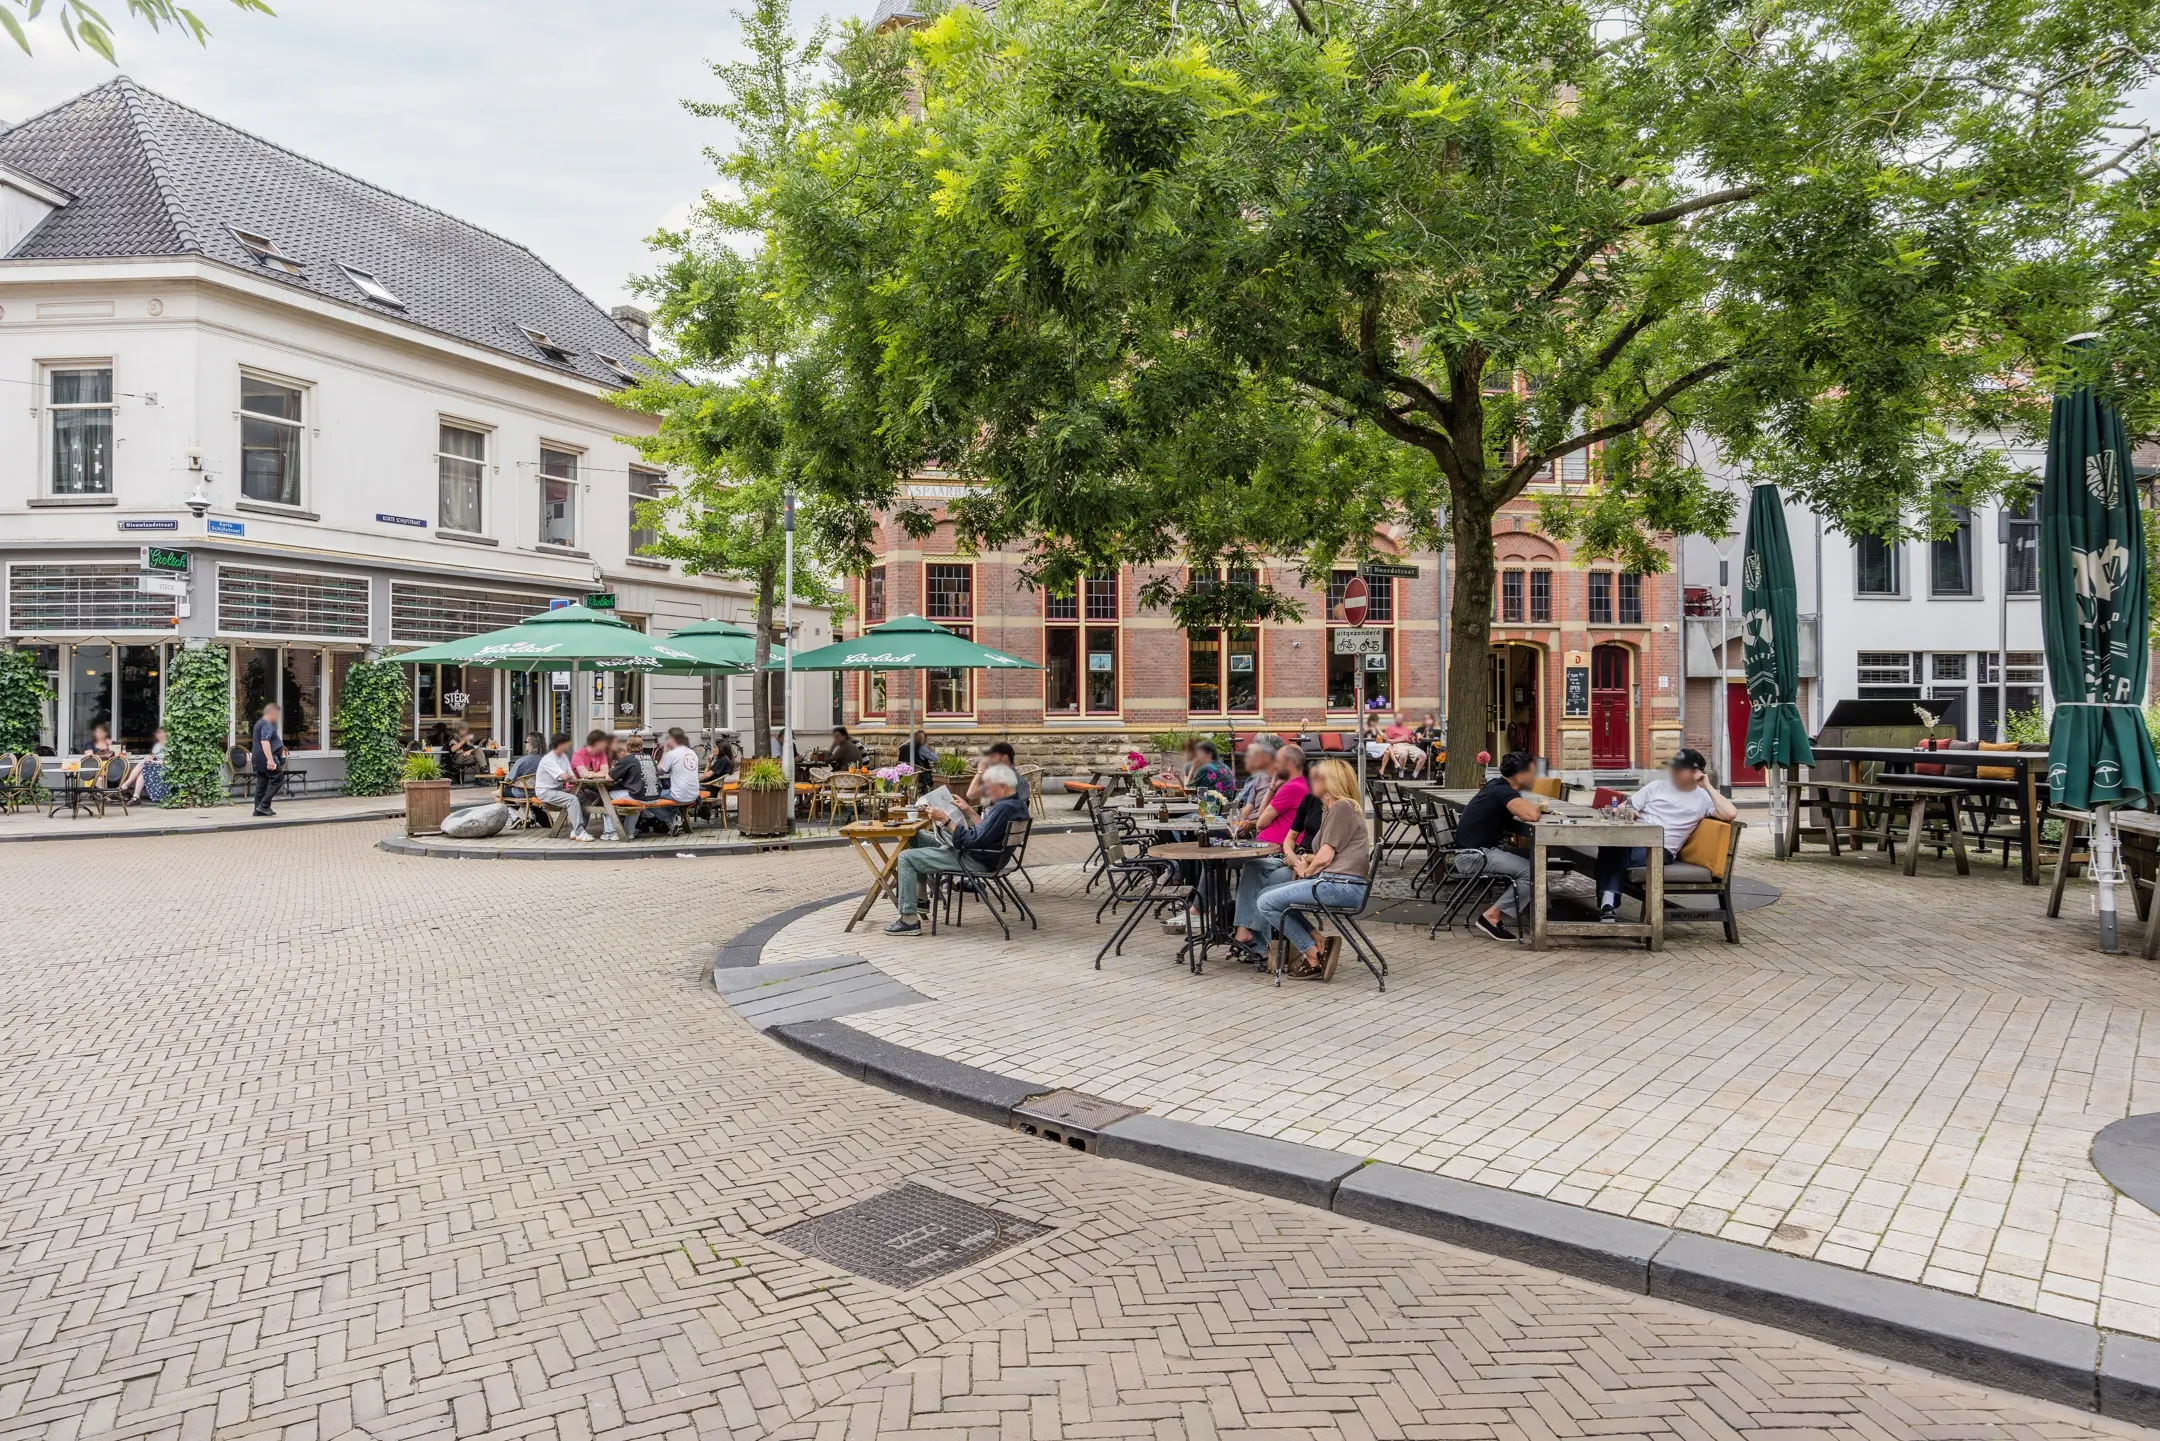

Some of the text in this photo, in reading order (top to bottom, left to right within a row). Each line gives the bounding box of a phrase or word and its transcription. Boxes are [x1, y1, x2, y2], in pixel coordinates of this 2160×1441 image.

[915, 485, 970, 497] SPAARBA
[211, 525, 240, 533] Schijfstraat
[150, 549, 186, 567] Grolsch
[1374, 567, 1415, 575] Noordstraat
[842, 652, 916, 665] Grolsch
